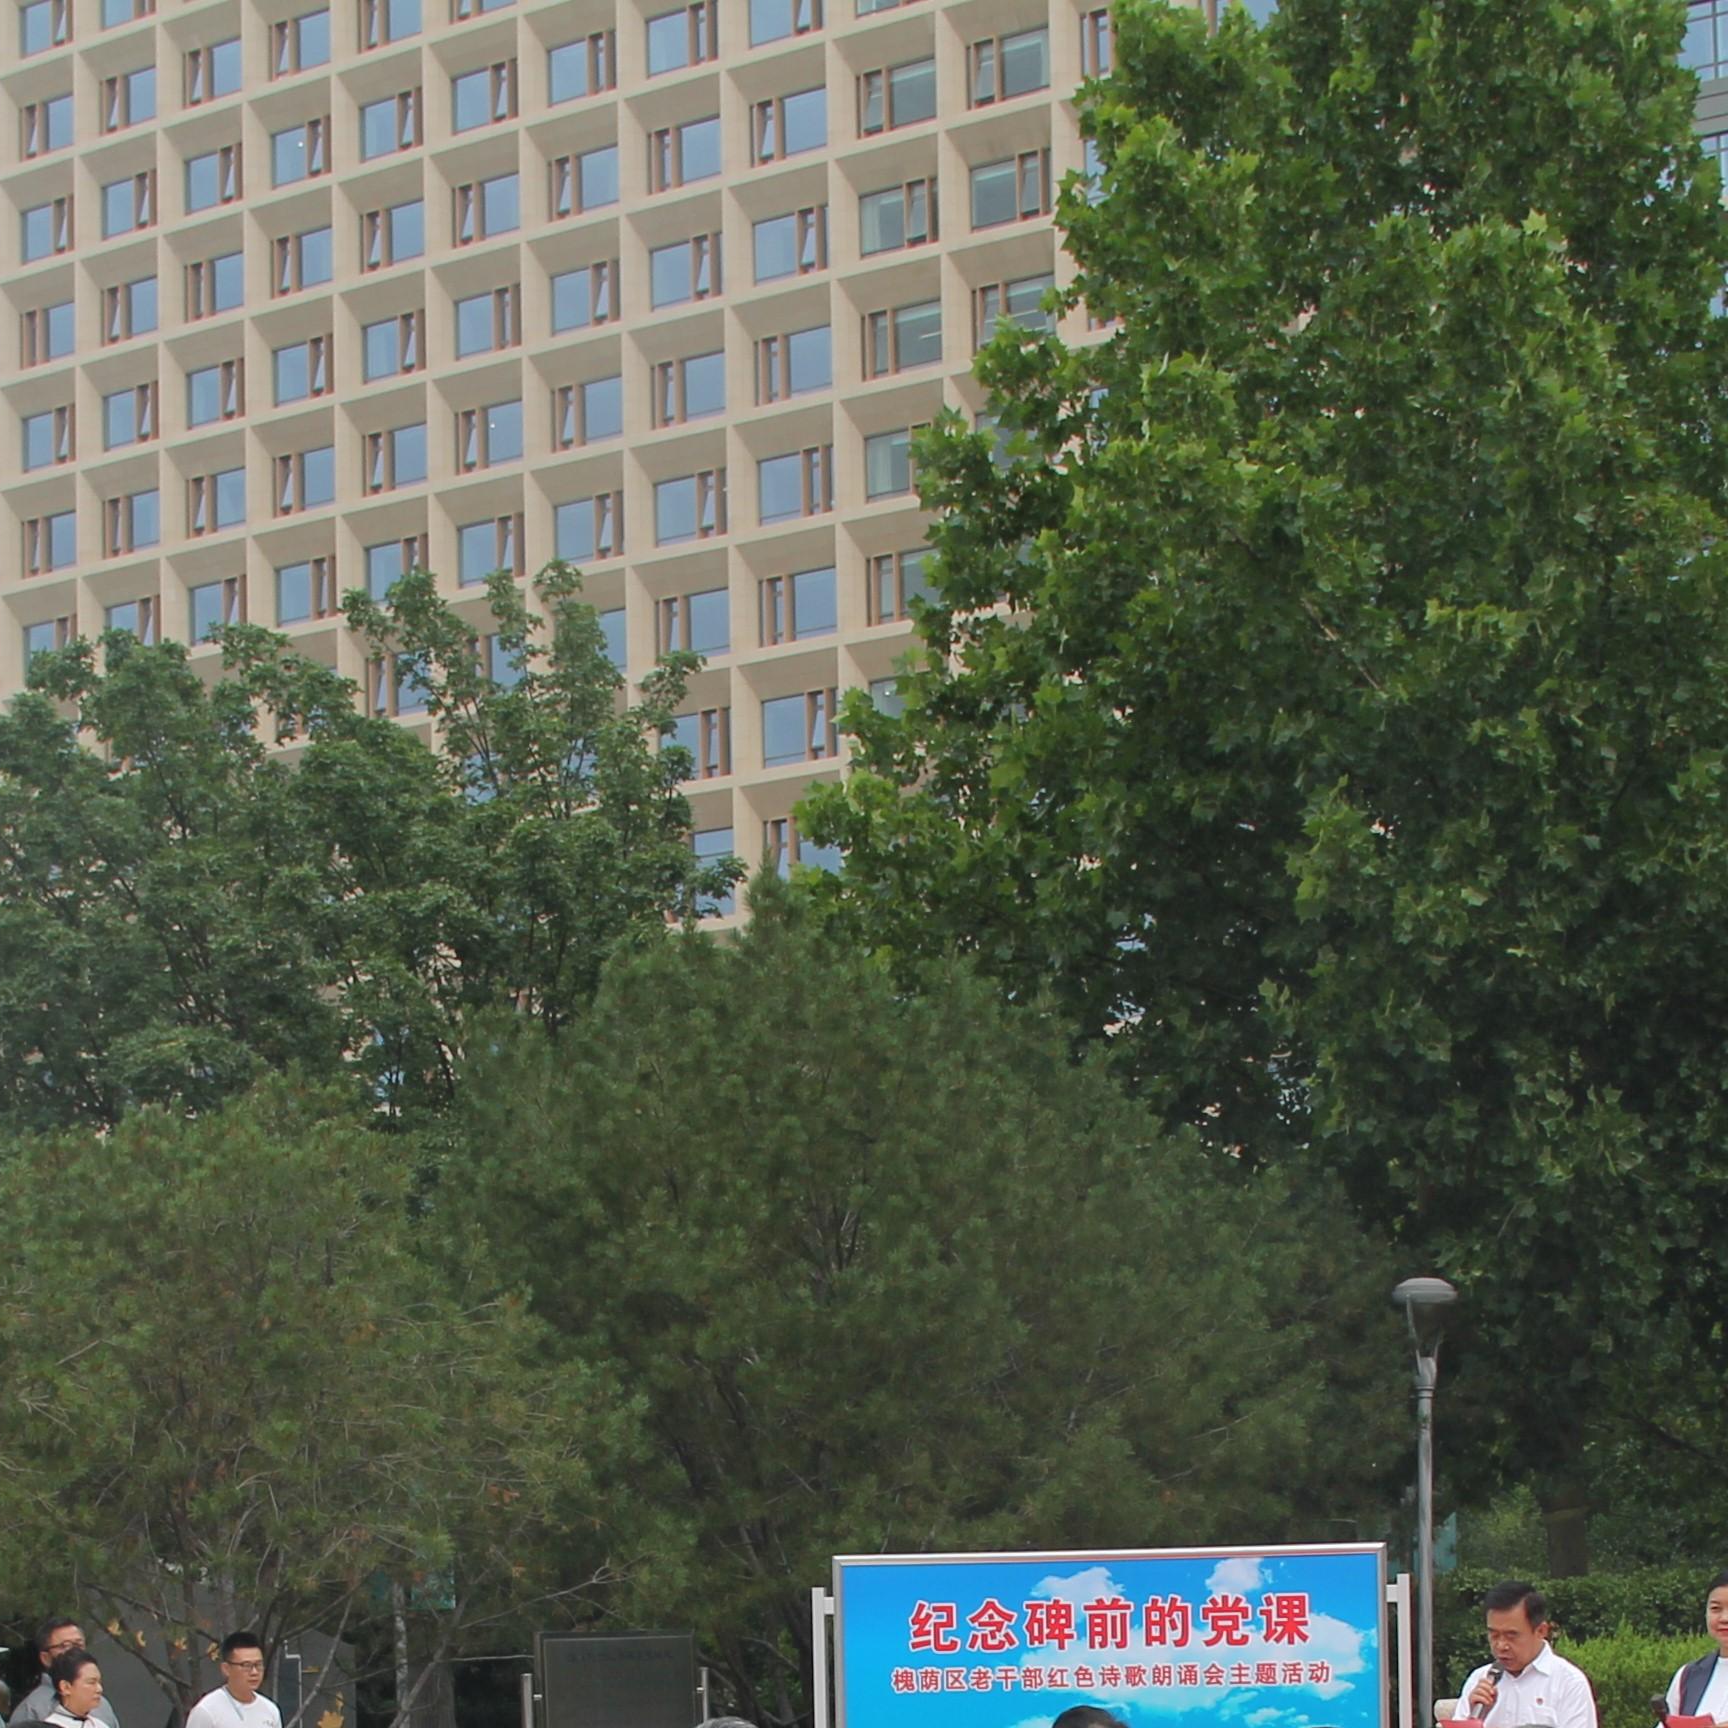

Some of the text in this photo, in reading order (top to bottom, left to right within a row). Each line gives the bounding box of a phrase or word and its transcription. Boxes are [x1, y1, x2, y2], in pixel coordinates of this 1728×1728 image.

[908, 1592, 1313, 1653] 纪念碑前的党课
[891, 1661, 1331, 1692] 槐荫区老干部红色诗歌朗诵会主题活动
